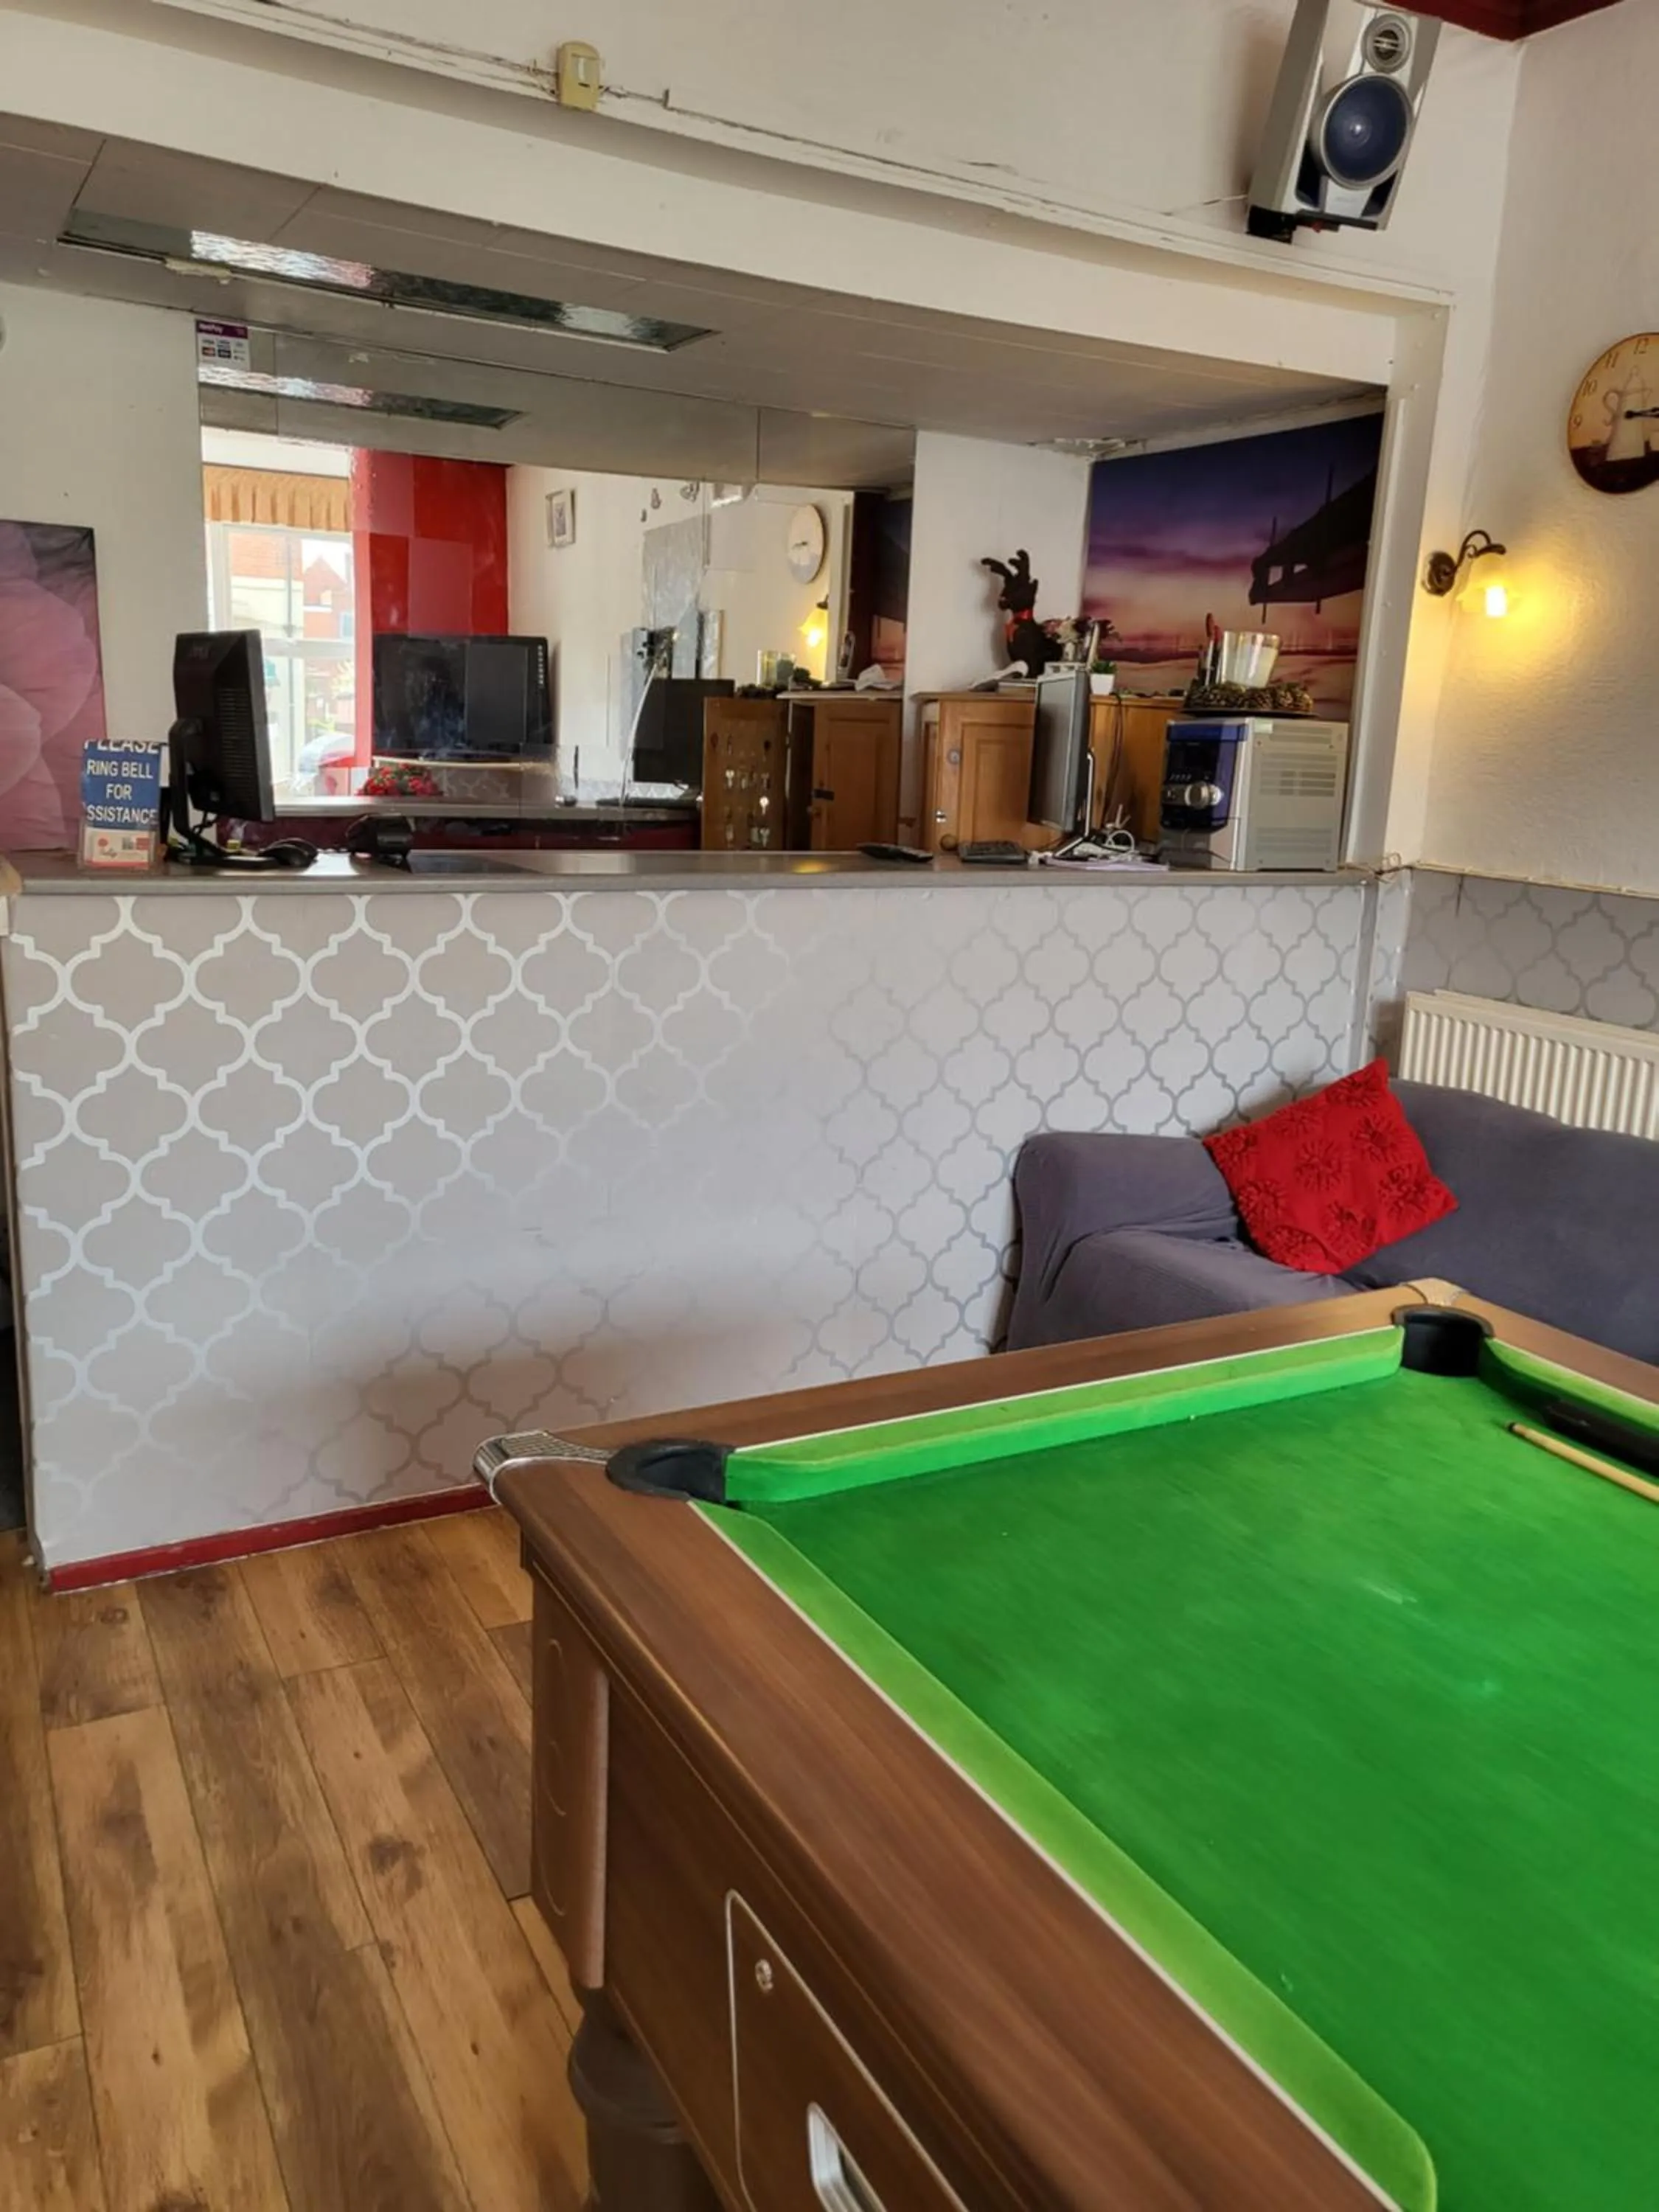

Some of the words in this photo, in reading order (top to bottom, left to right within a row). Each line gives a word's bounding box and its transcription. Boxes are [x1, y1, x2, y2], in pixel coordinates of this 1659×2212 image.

[1606, 352, 1619, 368] 11
[87, 759, 118, 776] RING
[122, 761, 153, 779] BELL
[105, 783, 132, 801] FOR
